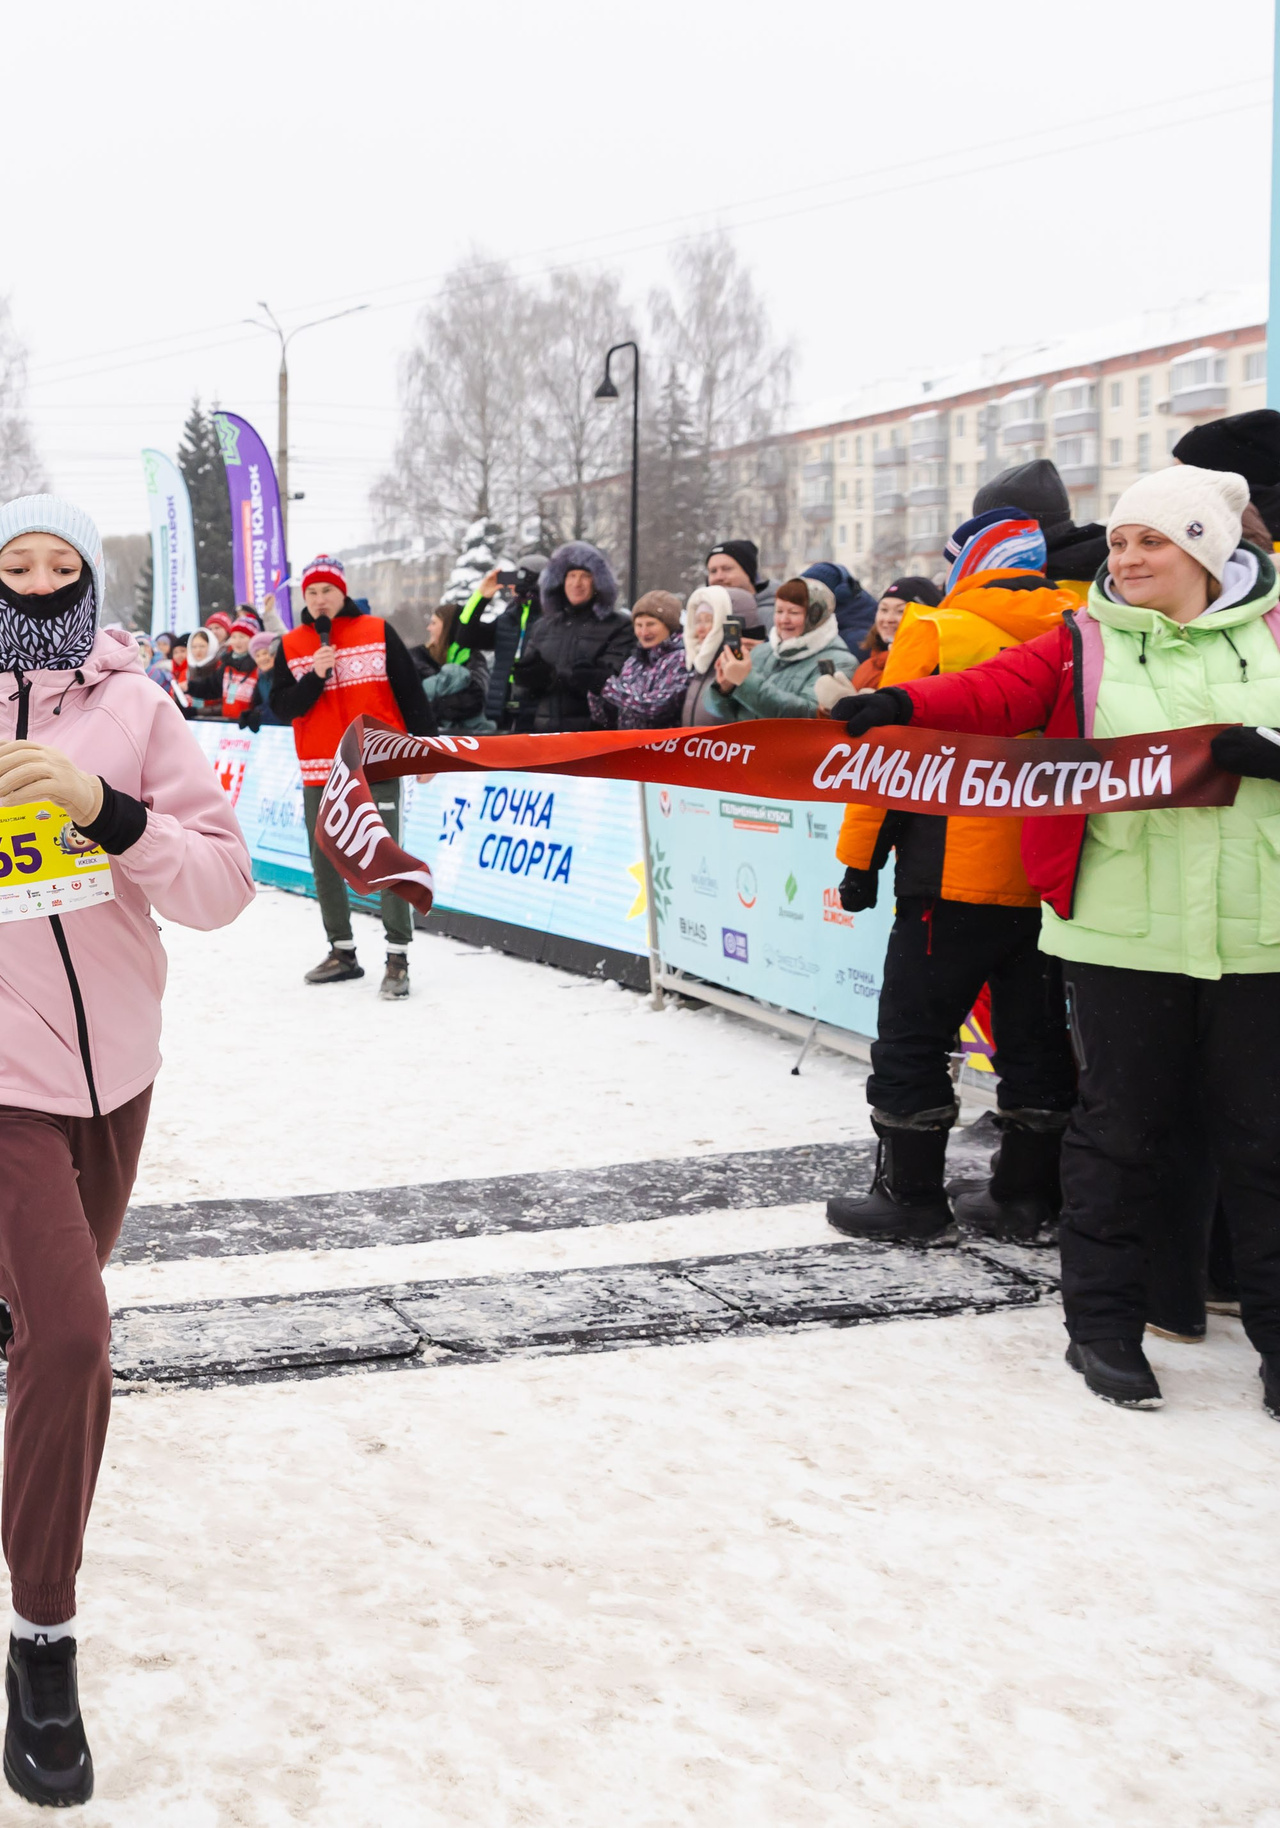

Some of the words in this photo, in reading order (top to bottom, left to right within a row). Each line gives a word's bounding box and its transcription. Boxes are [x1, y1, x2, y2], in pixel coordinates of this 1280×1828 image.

[684, 737, 756, 765] СПОРТ
[812, 743, 957, 804] САМЫЙ
[959, 744, 1172, 807] БЫСТРЫЙ
[479, 786, 555, 829] ТОЧКА
[479, 833, 573, 884] СПОРТА
